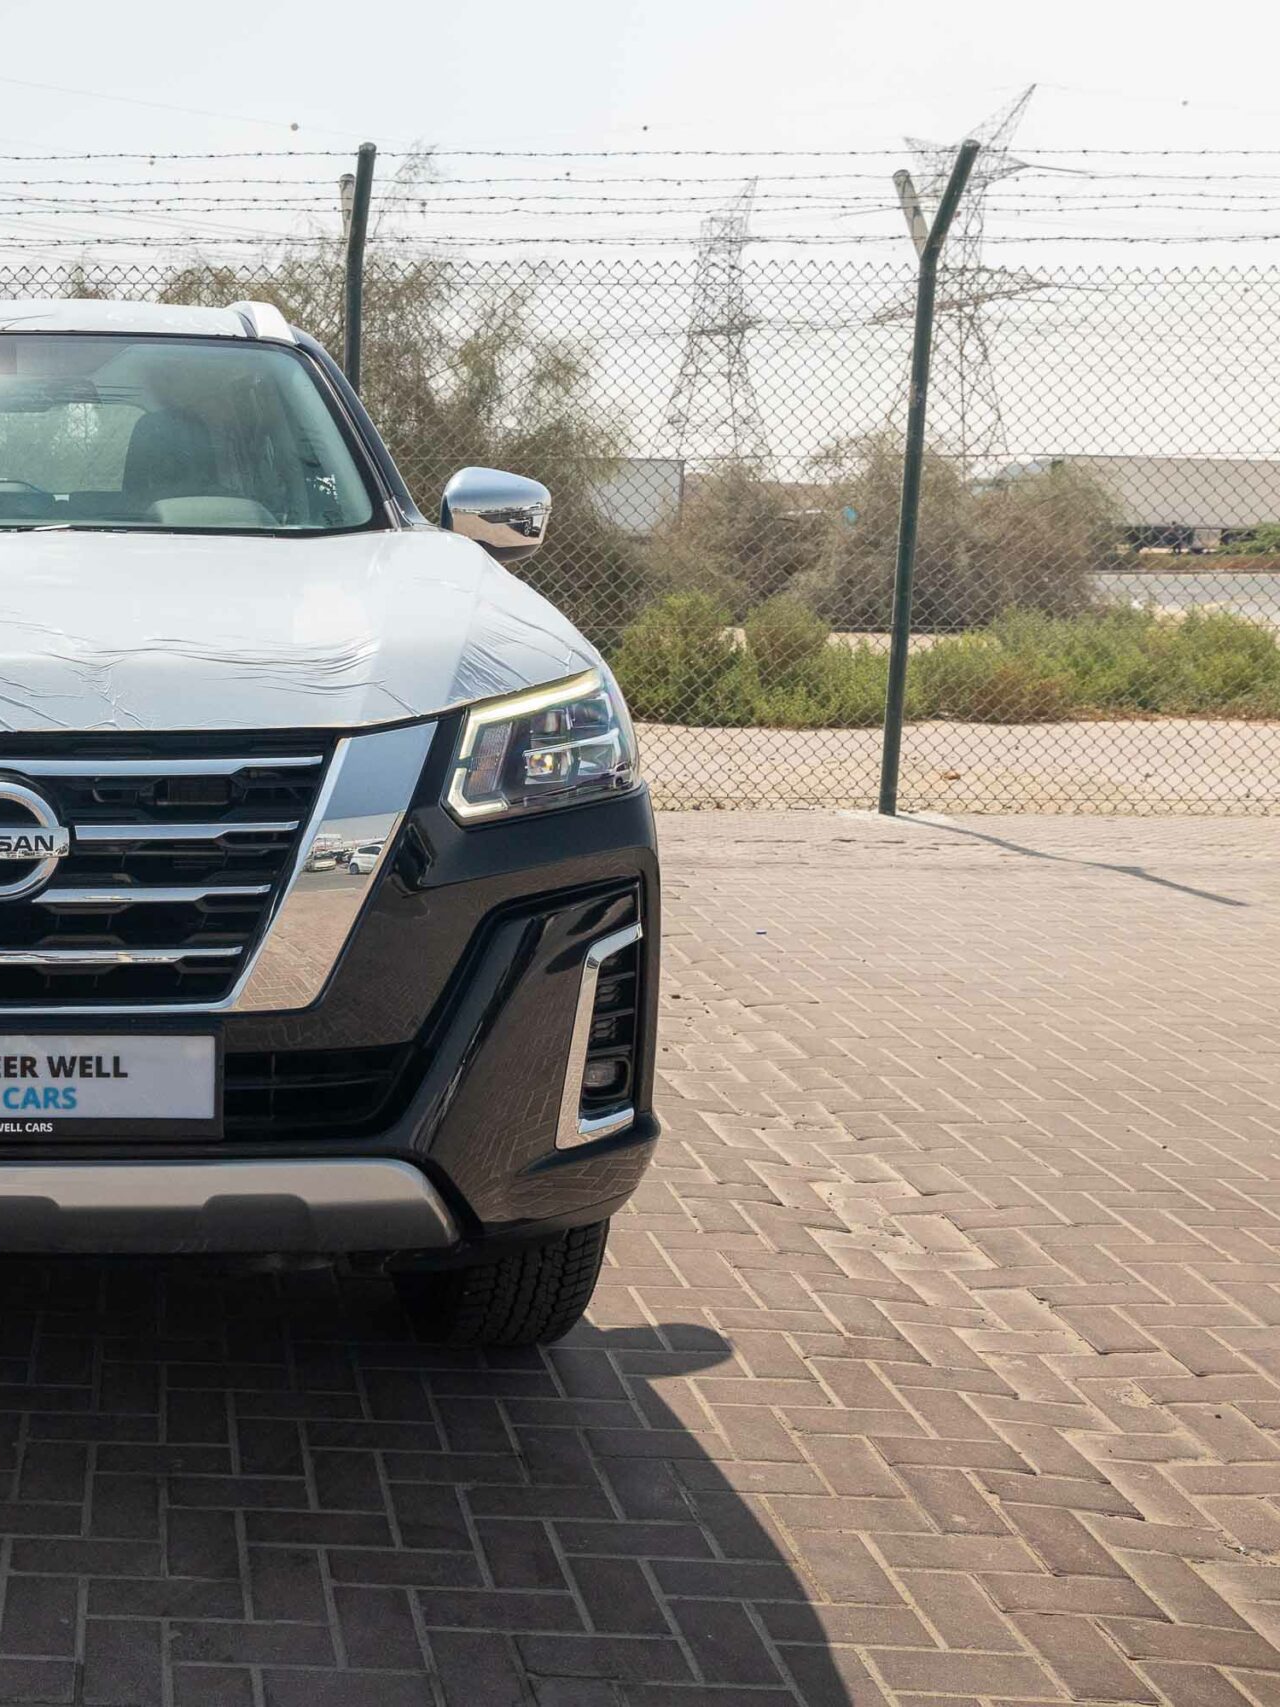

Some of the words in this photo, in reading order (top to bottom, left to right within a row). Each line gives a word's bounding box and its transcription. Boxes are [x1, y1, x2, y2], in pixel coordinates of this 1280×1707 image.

[46, 1055, 129, 1079] WELL
[2, 1086, 78, 1110] CARS
[25, 1122, 54, 1133] CARS
